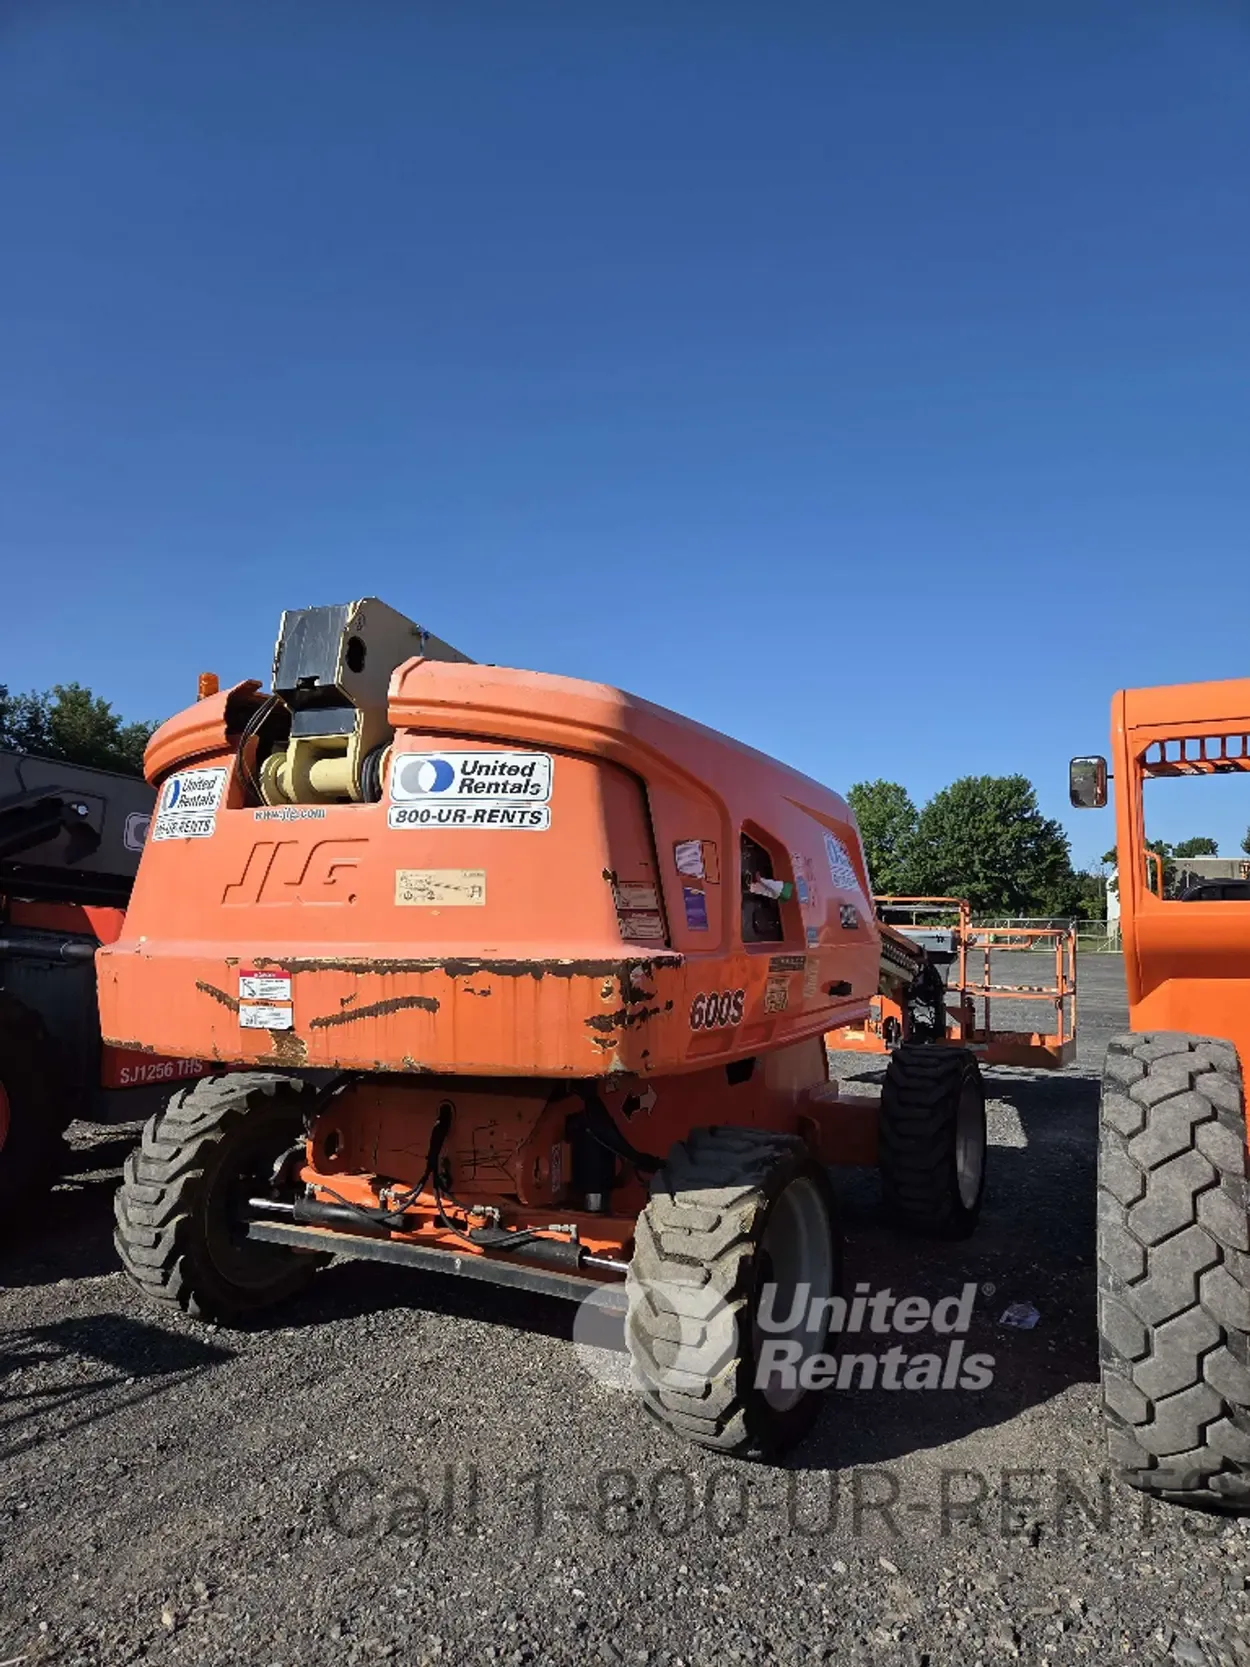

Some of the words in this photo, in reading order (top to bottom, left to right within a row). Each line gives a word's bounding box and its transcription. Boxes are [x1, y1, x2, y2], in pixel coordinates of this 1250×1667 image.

[460, 760, 536, 777] United
[182, 776, 217, 792] United
[457, 778, 542, 796] Rentals
[177, 792, 216, 808] Rentals
[254, 807, 326, 821] www.jlg.com
[395, 808, 543, 825] 800-UR-RENTS
[690, 988, 746, 1031] 600S
[120, 1062, 173, 1084] SJ1256
[177, 1058, 203, 1076] THS
